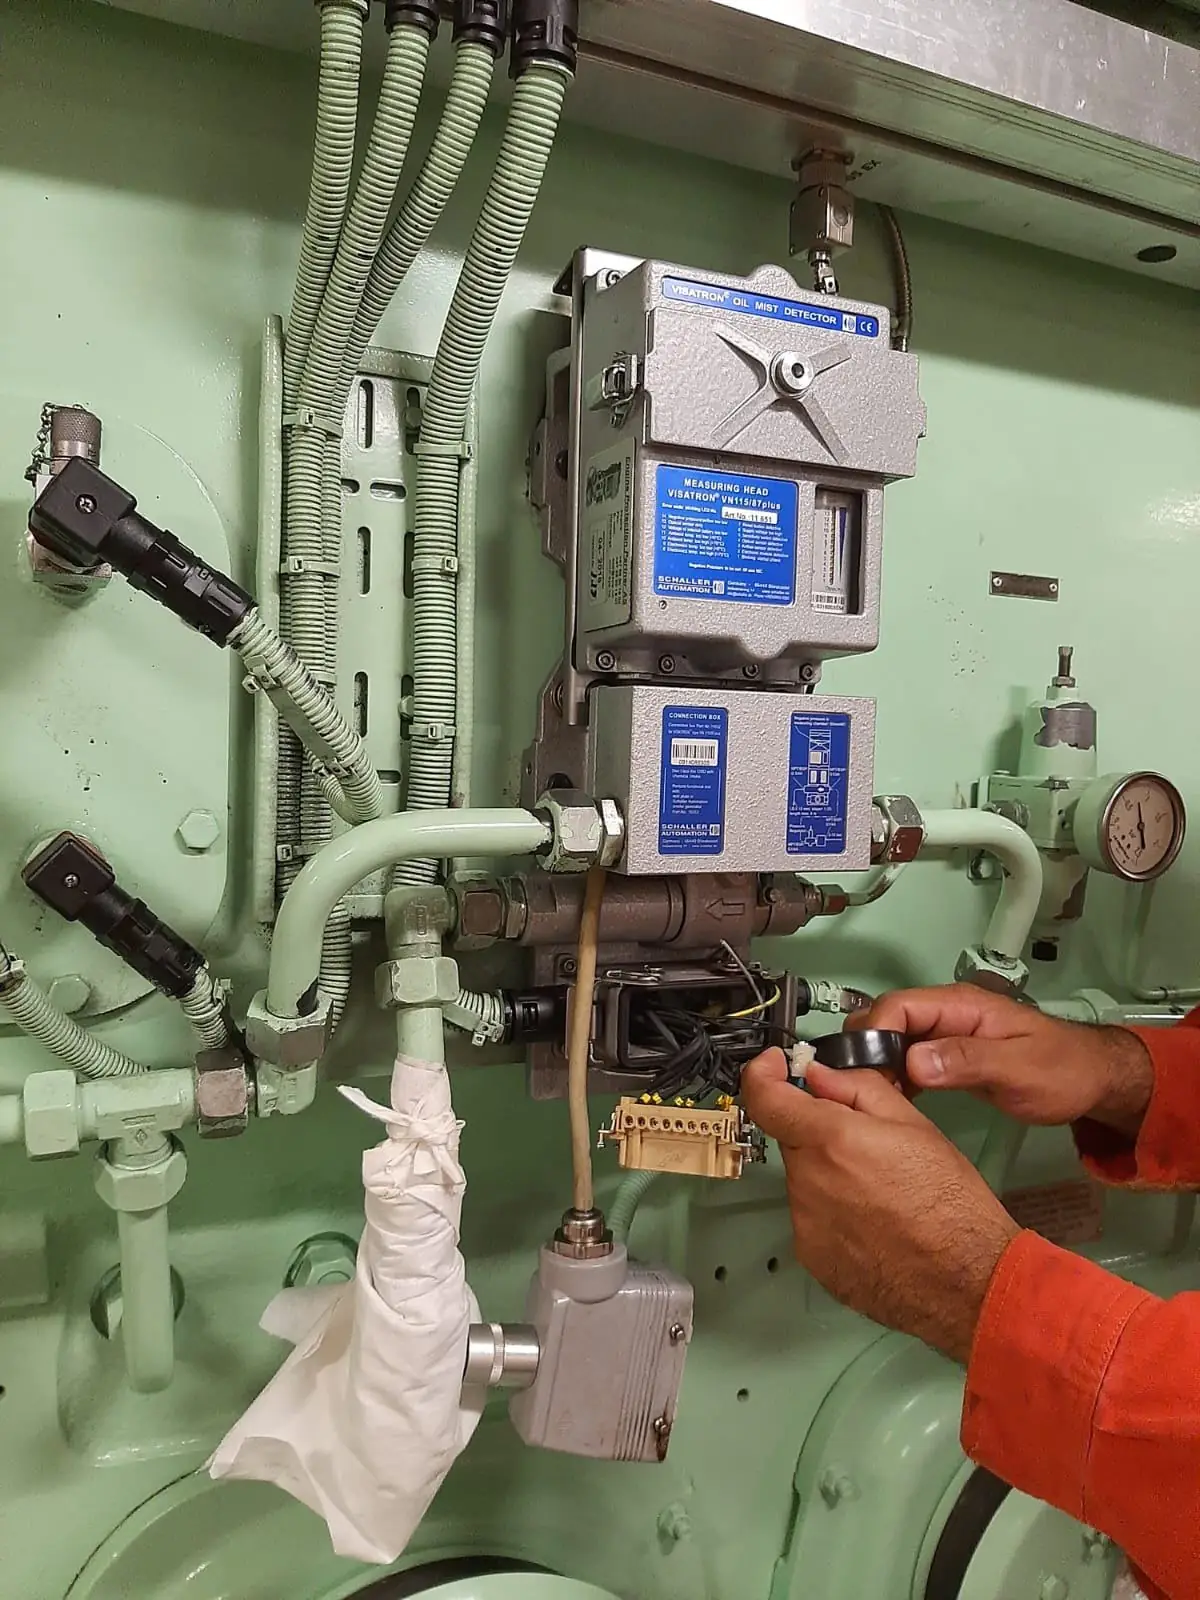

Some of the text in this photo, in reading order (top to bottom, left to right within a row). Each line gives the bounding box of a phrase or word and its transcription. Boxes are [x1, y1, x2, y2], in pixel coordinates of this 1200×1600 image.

[732, 296, 750, 309] OIL
[755, 301, 779, 314] MIST
[784, 306, 838, 325] DETECTOR
[684, 478, 769, 496] MEASURING HEAD
[721, 495, 781, 510] VN115/87plus
[658, 575, 711, 585] SCHALLER
[657, 583, 711, 594] AUTOMATION
[669, 712, 708, 720] CONNECTION
